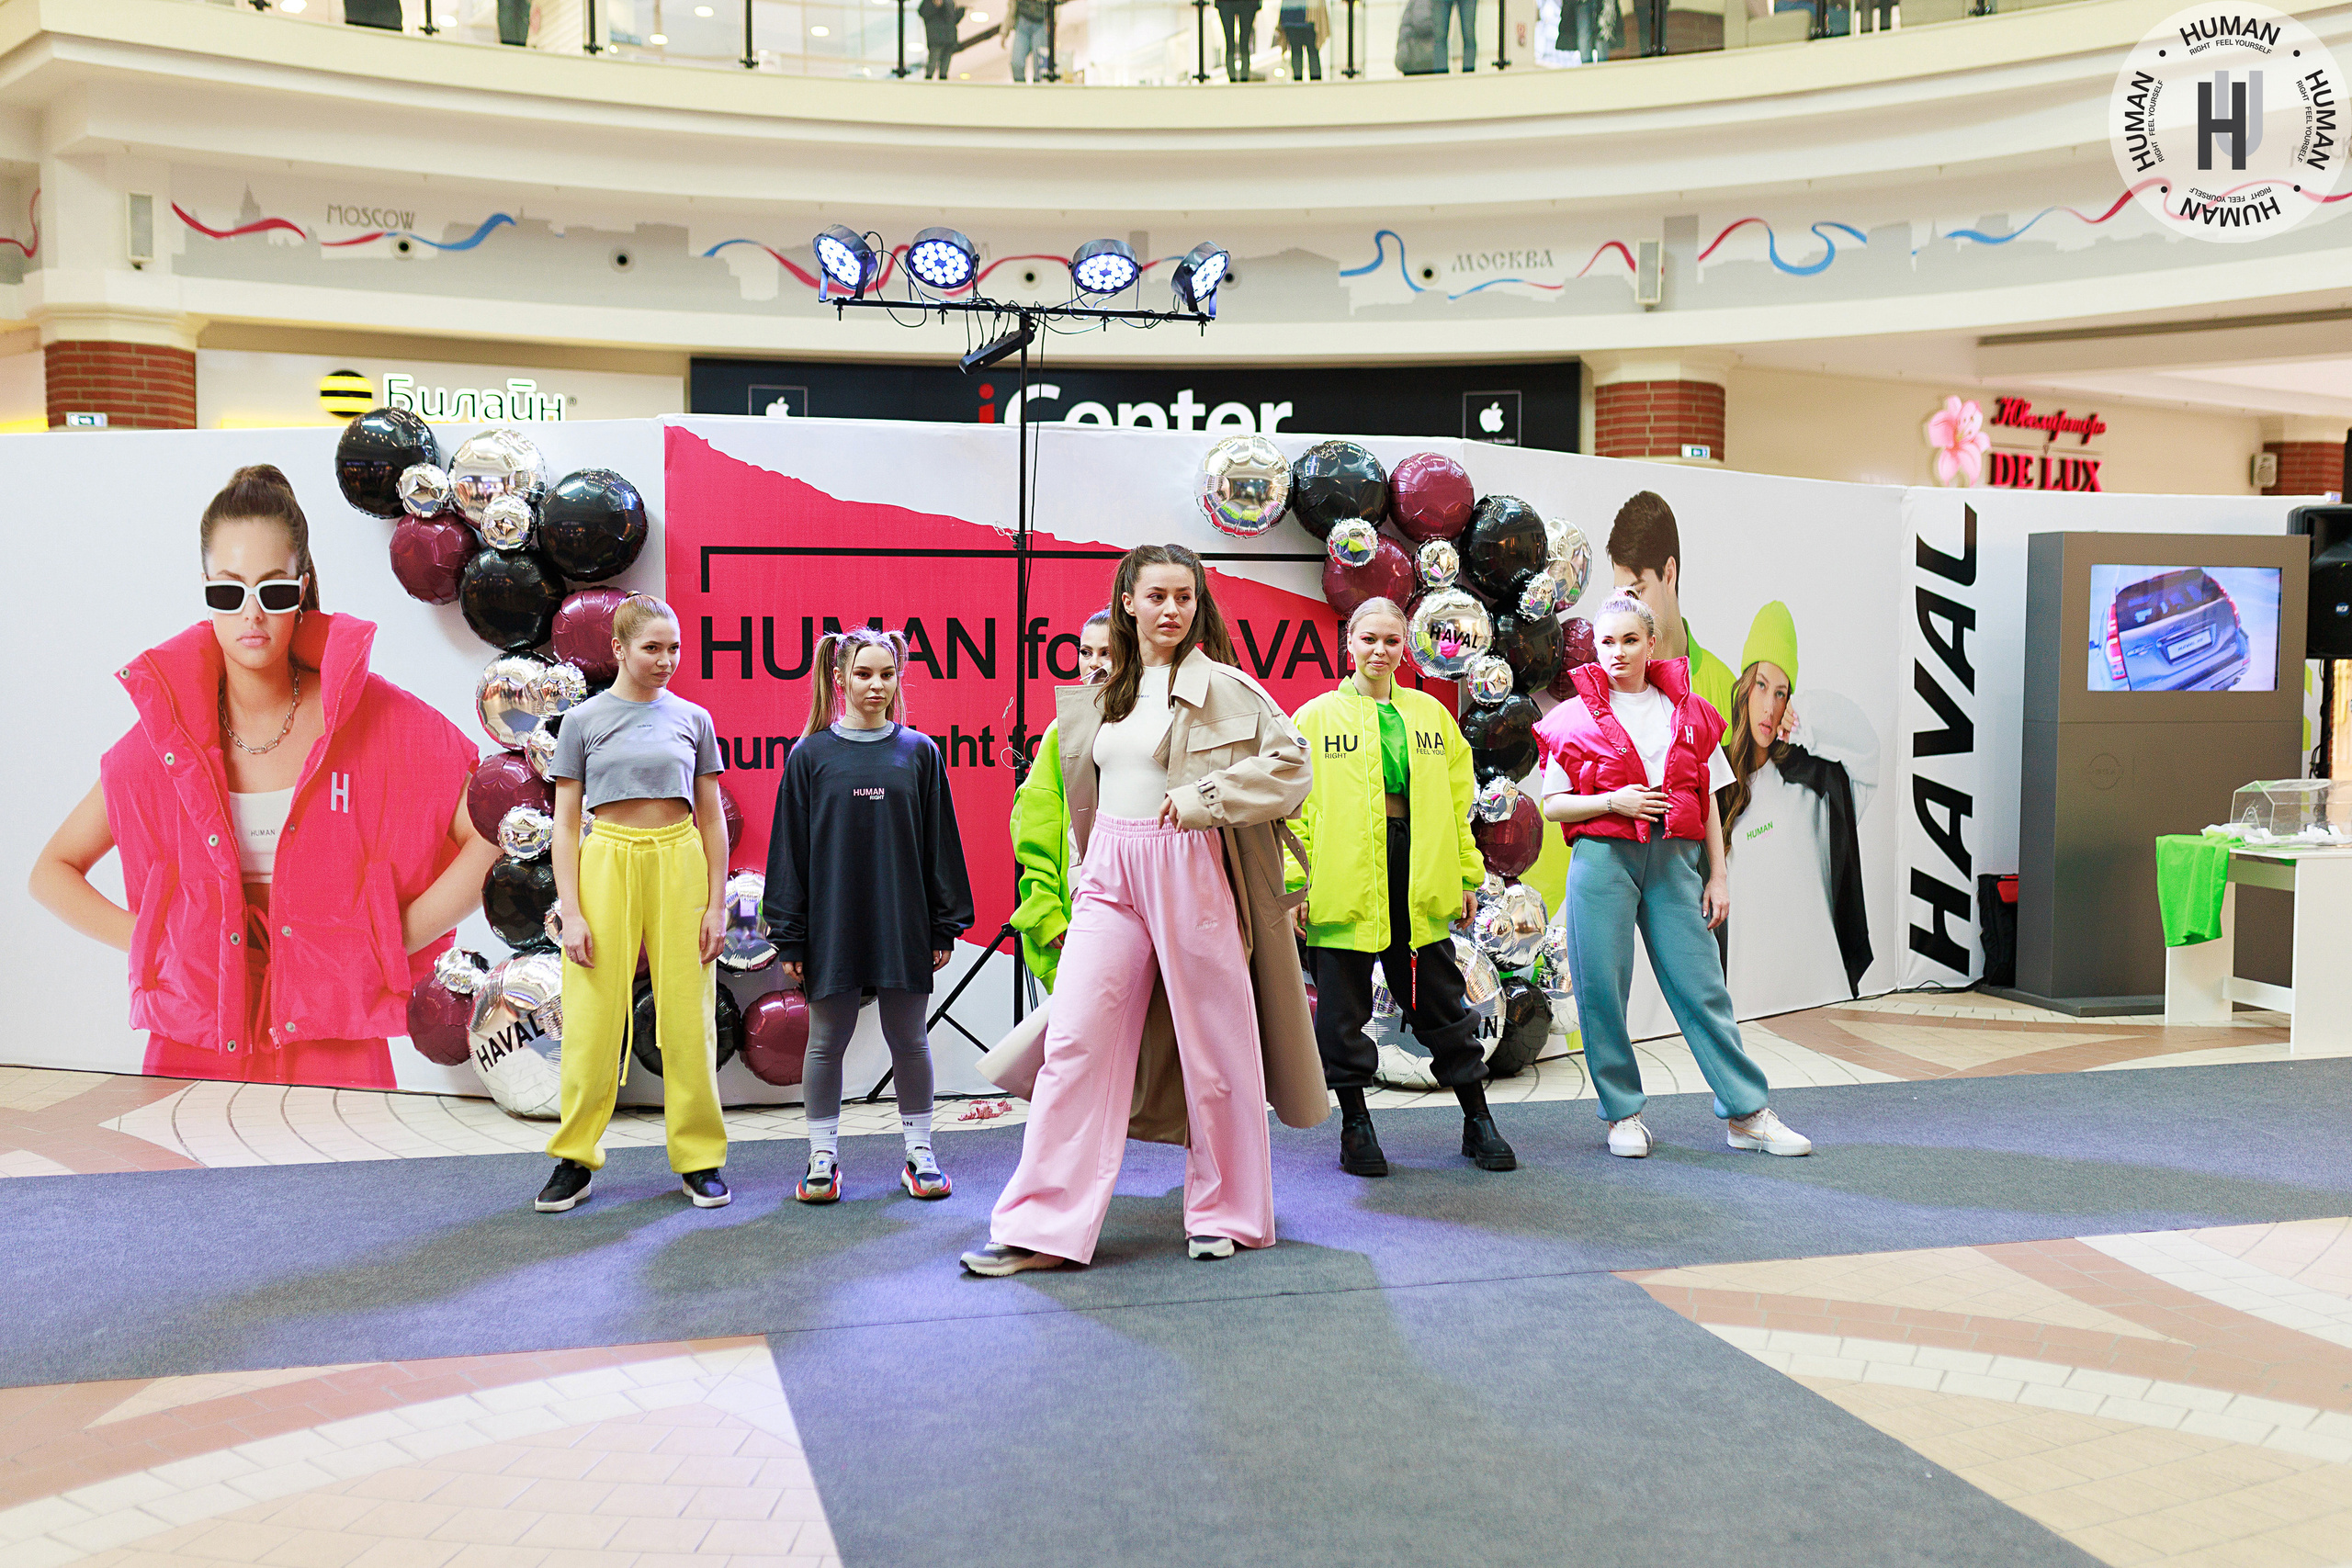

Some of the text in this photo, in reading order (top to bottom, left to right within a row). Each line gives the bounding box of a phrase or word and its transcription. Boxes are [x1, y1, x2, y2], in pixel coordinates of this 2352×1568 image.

[326, 203, 415, 230] MOSCOW
[1451, 248, 1555, 273] МОСКВА
[382, 372, 566, 423] Билайн
[1988, 452, 2102, 491] DE LUX
[701, 616, 996, 680] HUAN
[1023, 617, 1081, 680] fo
[1430, 625, 1477, 649] HAVAL
[1325, 730, 1445, 752] HU MA
[1684, 725, 1694, 745] H
[1909, 502, 1978, 977] HAVAL
[331, 772, 349, 814] H
[853, 787, 885, 796] HUMAN
[250, 829, 276, 837] HUMAN
[1747, 820, 1773, 841] HUMAN
[476, 1012, 546, 1073] HAVAL
